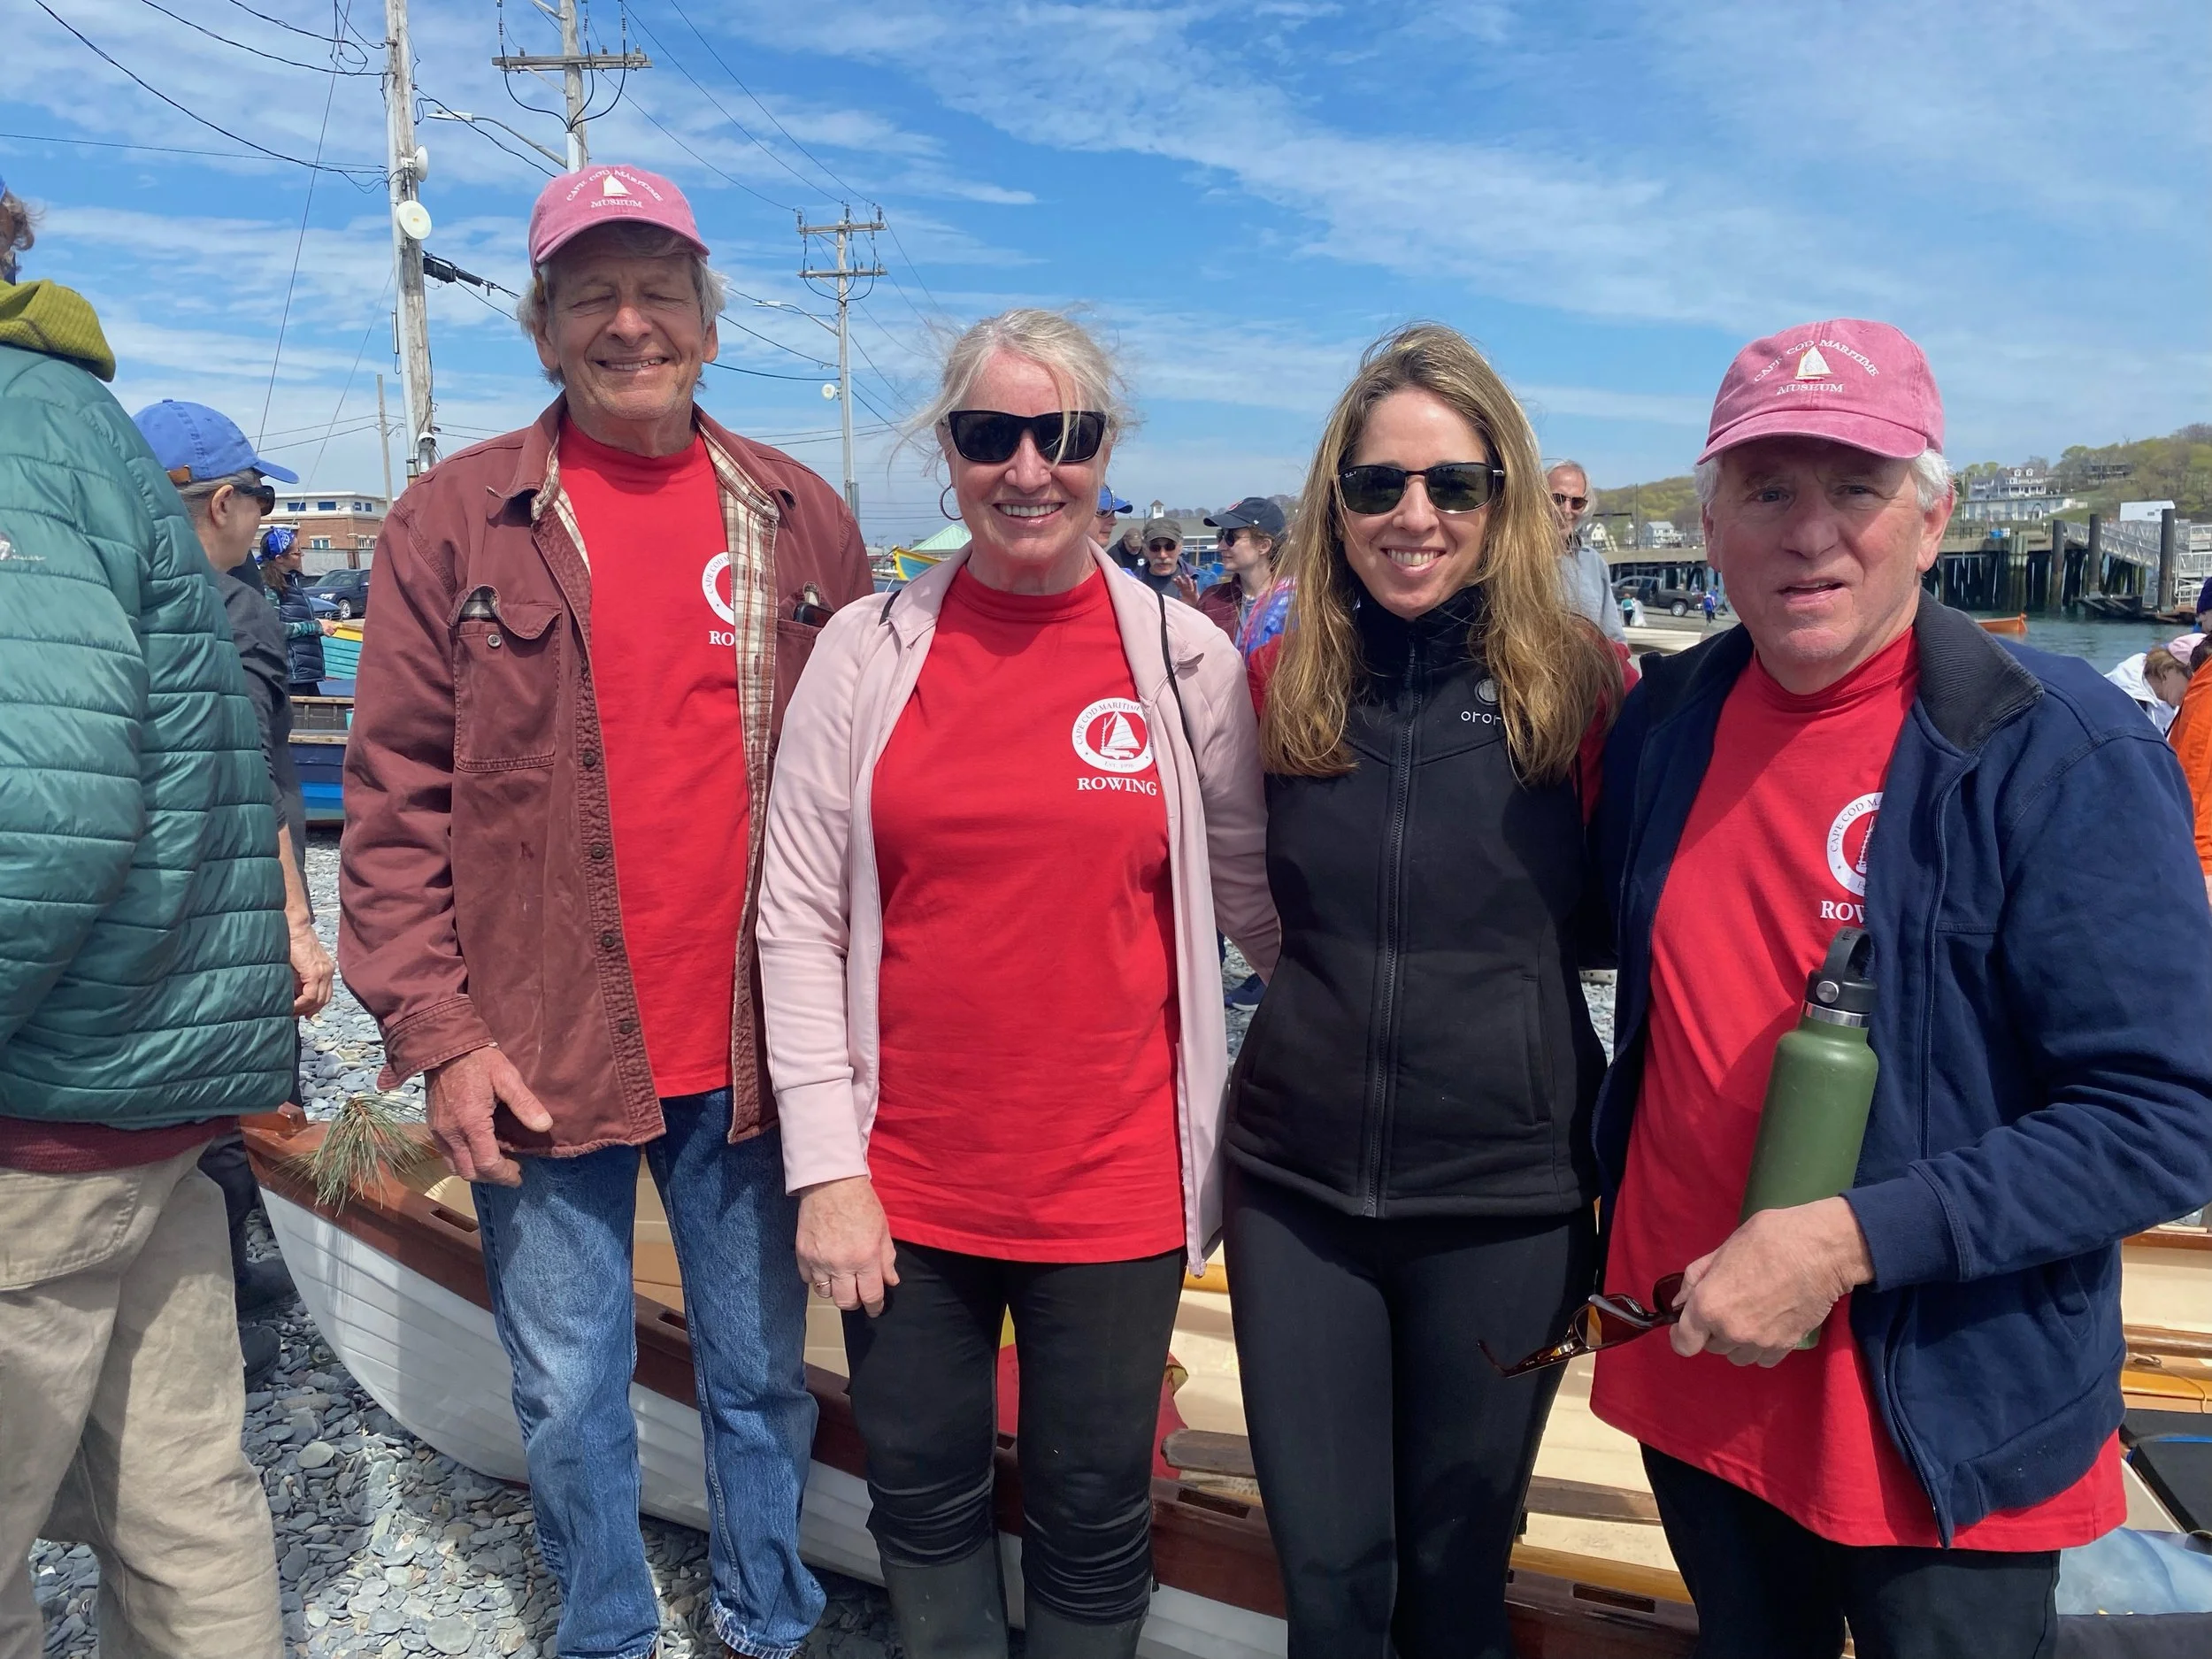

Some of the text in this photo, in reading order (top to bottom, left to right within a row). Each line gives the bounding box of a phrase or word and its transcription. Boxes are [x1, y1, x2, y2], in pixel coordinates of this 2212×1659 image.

[566, 169, 664, 202] CAPE COD MARITIME
[590, 198, 643, 208] MUSEUM
[1755, 339, 1879, 381] CAPE COD MARITIME
[1777, 383, 1844, 396] MUSEUM
[711, 559, 724, 572] COD
[1082, 708, 1097, 723] COD
[1461, 710, 1502, 726] oror
[1077, 777, 1157, 795] ROWING
[1830, 803, 1864, 853] CAPE COD
